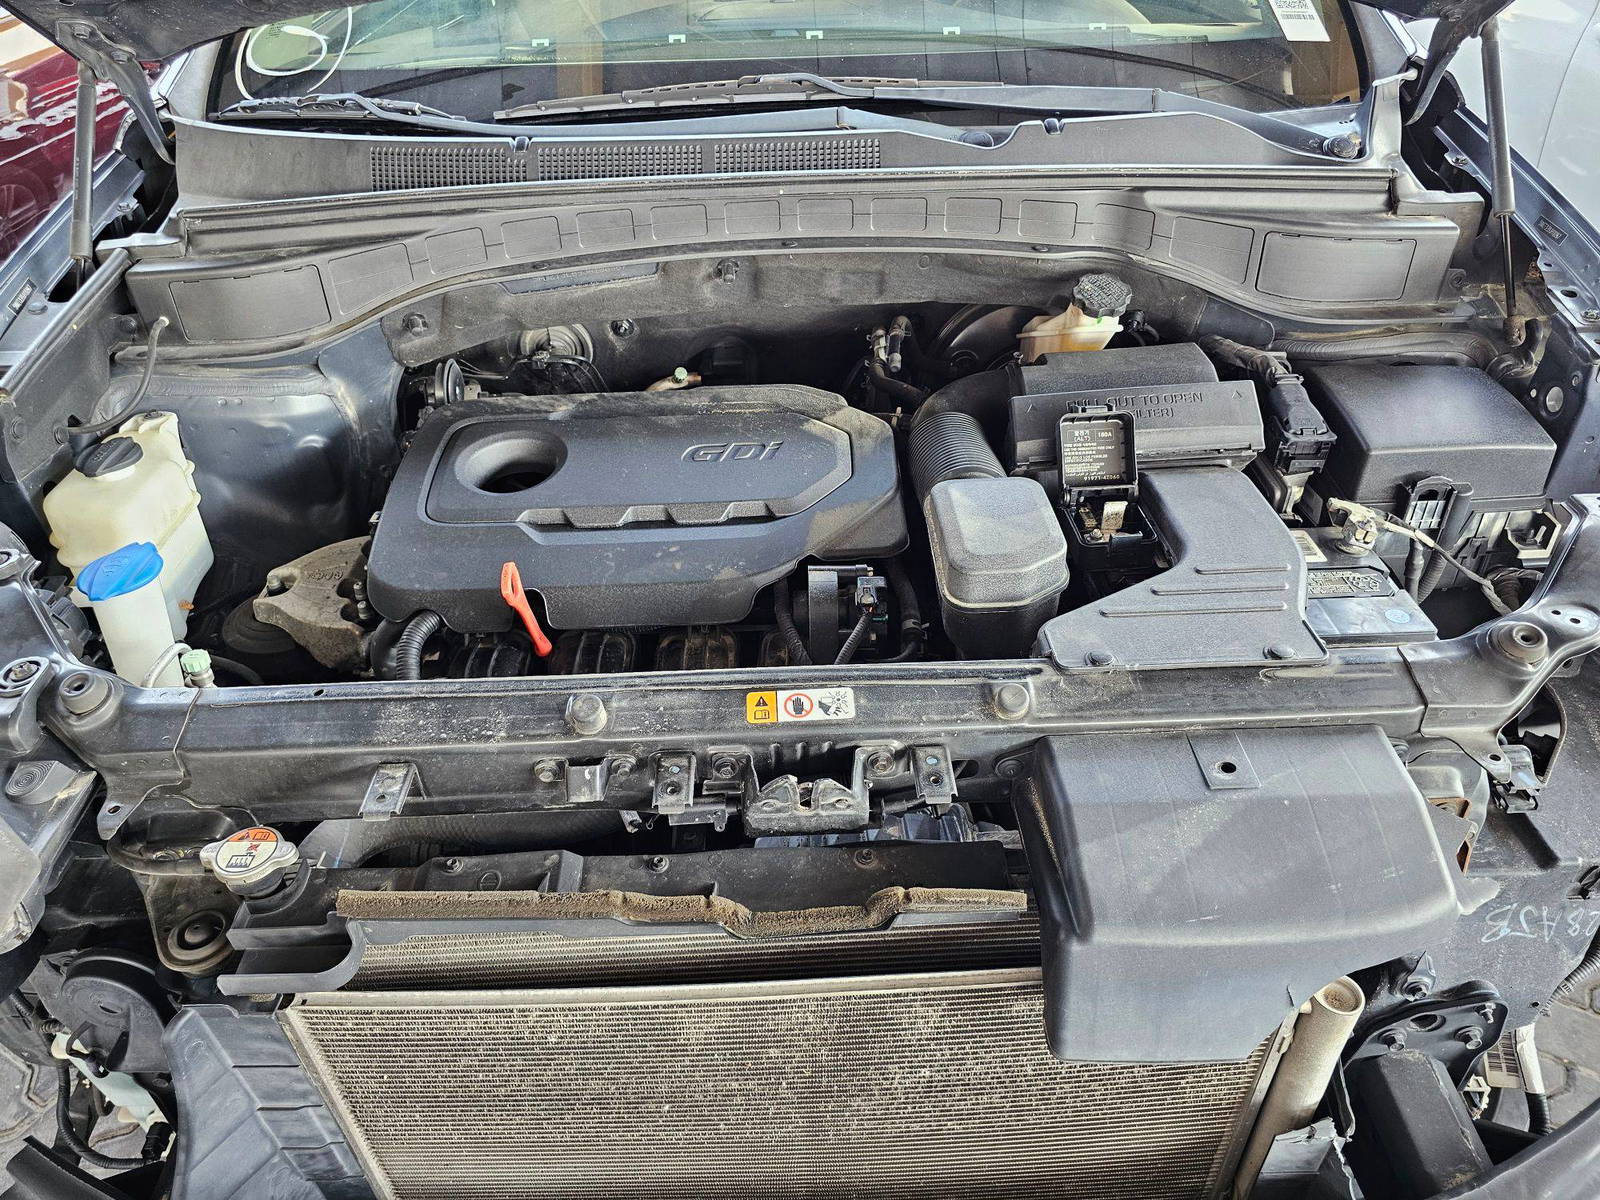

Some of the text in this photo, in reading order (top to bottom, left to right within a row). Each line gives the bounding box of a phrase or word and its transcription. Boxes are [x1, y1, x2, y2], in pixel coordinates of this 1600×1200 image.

[1106, 395, 1137, 407] OUT
[1138, 394, 1160, 406] TO
[1163, 392, 1204, 404] OPEN
[681, 441, 784, 462] GDi
